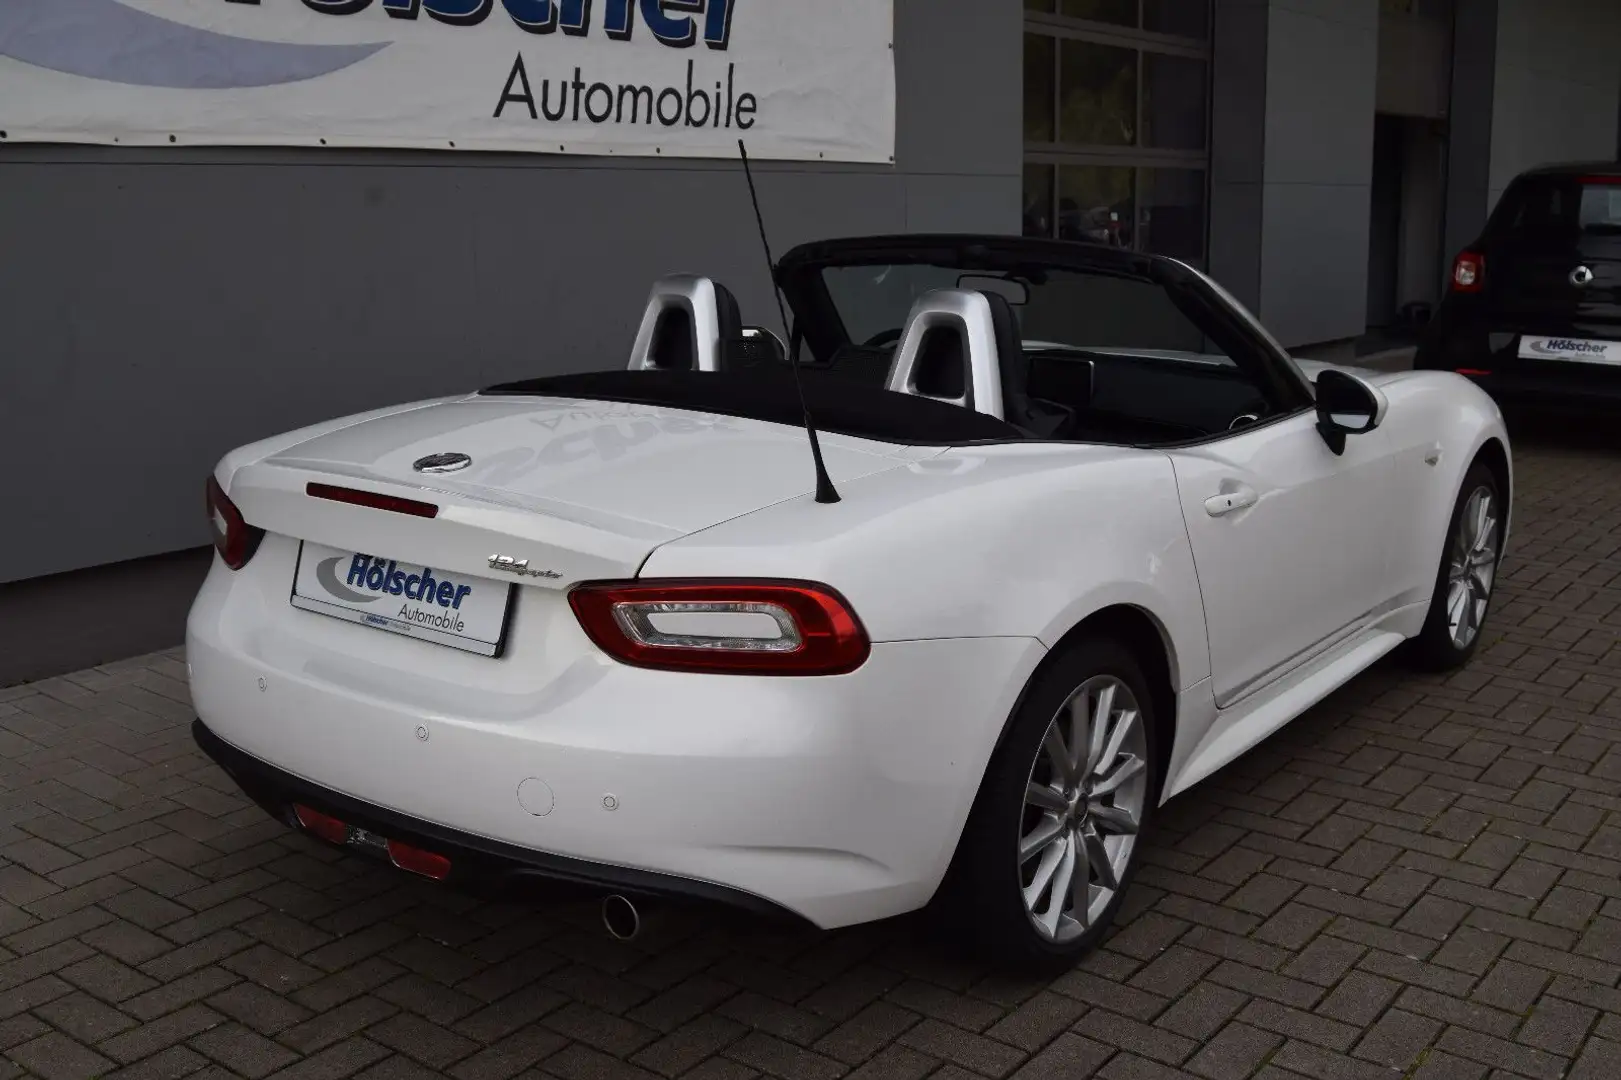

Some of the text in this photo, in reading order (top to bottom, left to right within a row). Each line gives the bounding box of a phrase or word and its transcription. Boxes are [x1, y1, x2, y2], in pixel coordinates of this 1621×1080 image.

[492, 51, 757, 130] Automobile
[1547, 340, 1607, 352] Hölscher
[346, 552, 472, 609] Hölscher
[397, 603, 465, 633] Automobile
